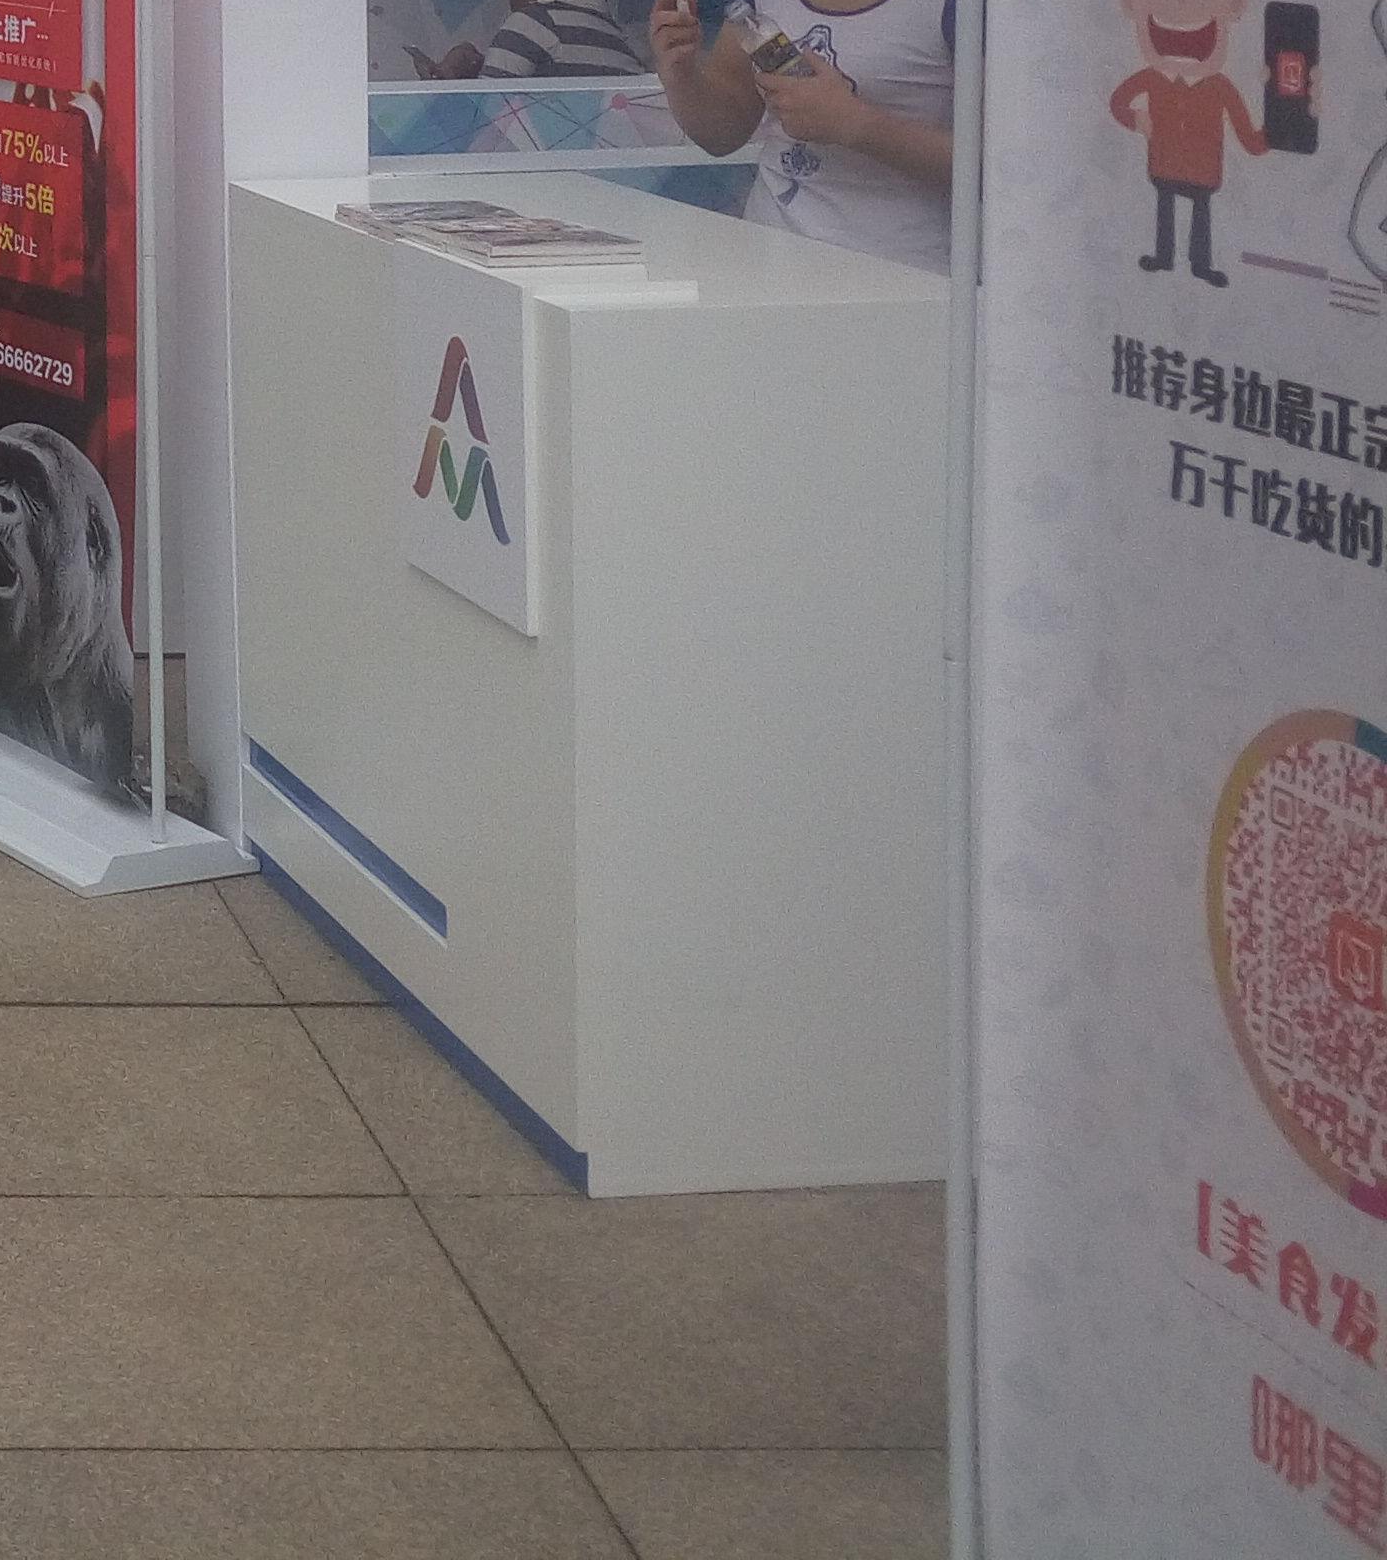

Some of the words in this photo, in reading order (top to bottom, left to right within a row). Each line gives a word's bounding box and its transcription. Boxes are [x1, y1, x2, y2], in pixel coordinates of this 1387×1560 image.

[1169, 439, 1383, 568] 万千吃货的
[1252, 1374, 1386, 1553] 哪里
